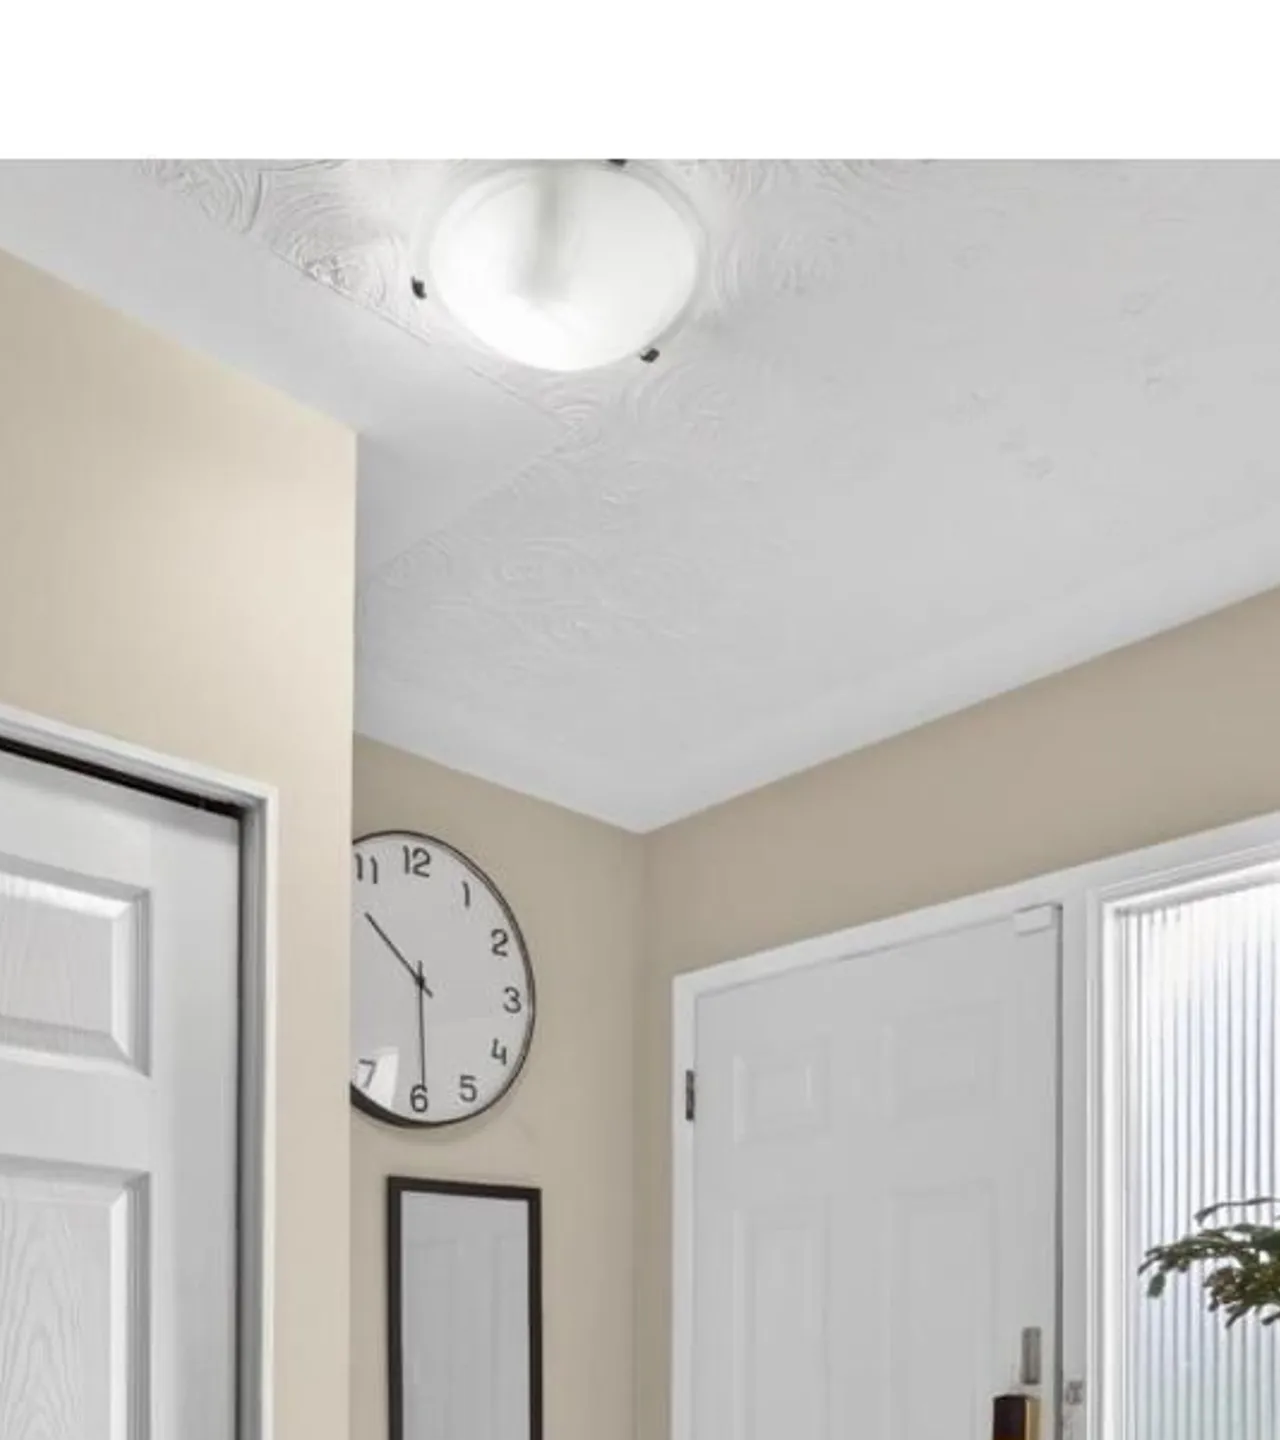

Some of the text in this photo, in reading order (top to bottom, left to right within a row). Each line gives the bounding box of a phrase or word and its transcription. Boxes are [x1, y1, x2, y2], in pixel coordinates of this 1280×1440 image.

[355, 853, 378, 884] 11
[402, 845, 431, 878] 12
[462, 881, 471, 909] 1
[490, 928, 509, 957] 2
[503, 986, 522, 1014] 3
[491, 1038, 507, 1066] 4
[359, 1058, 377, 1087] 7
[410, 1084, 429, 1113] 6
[459, 1075, 478, 1103] 5
